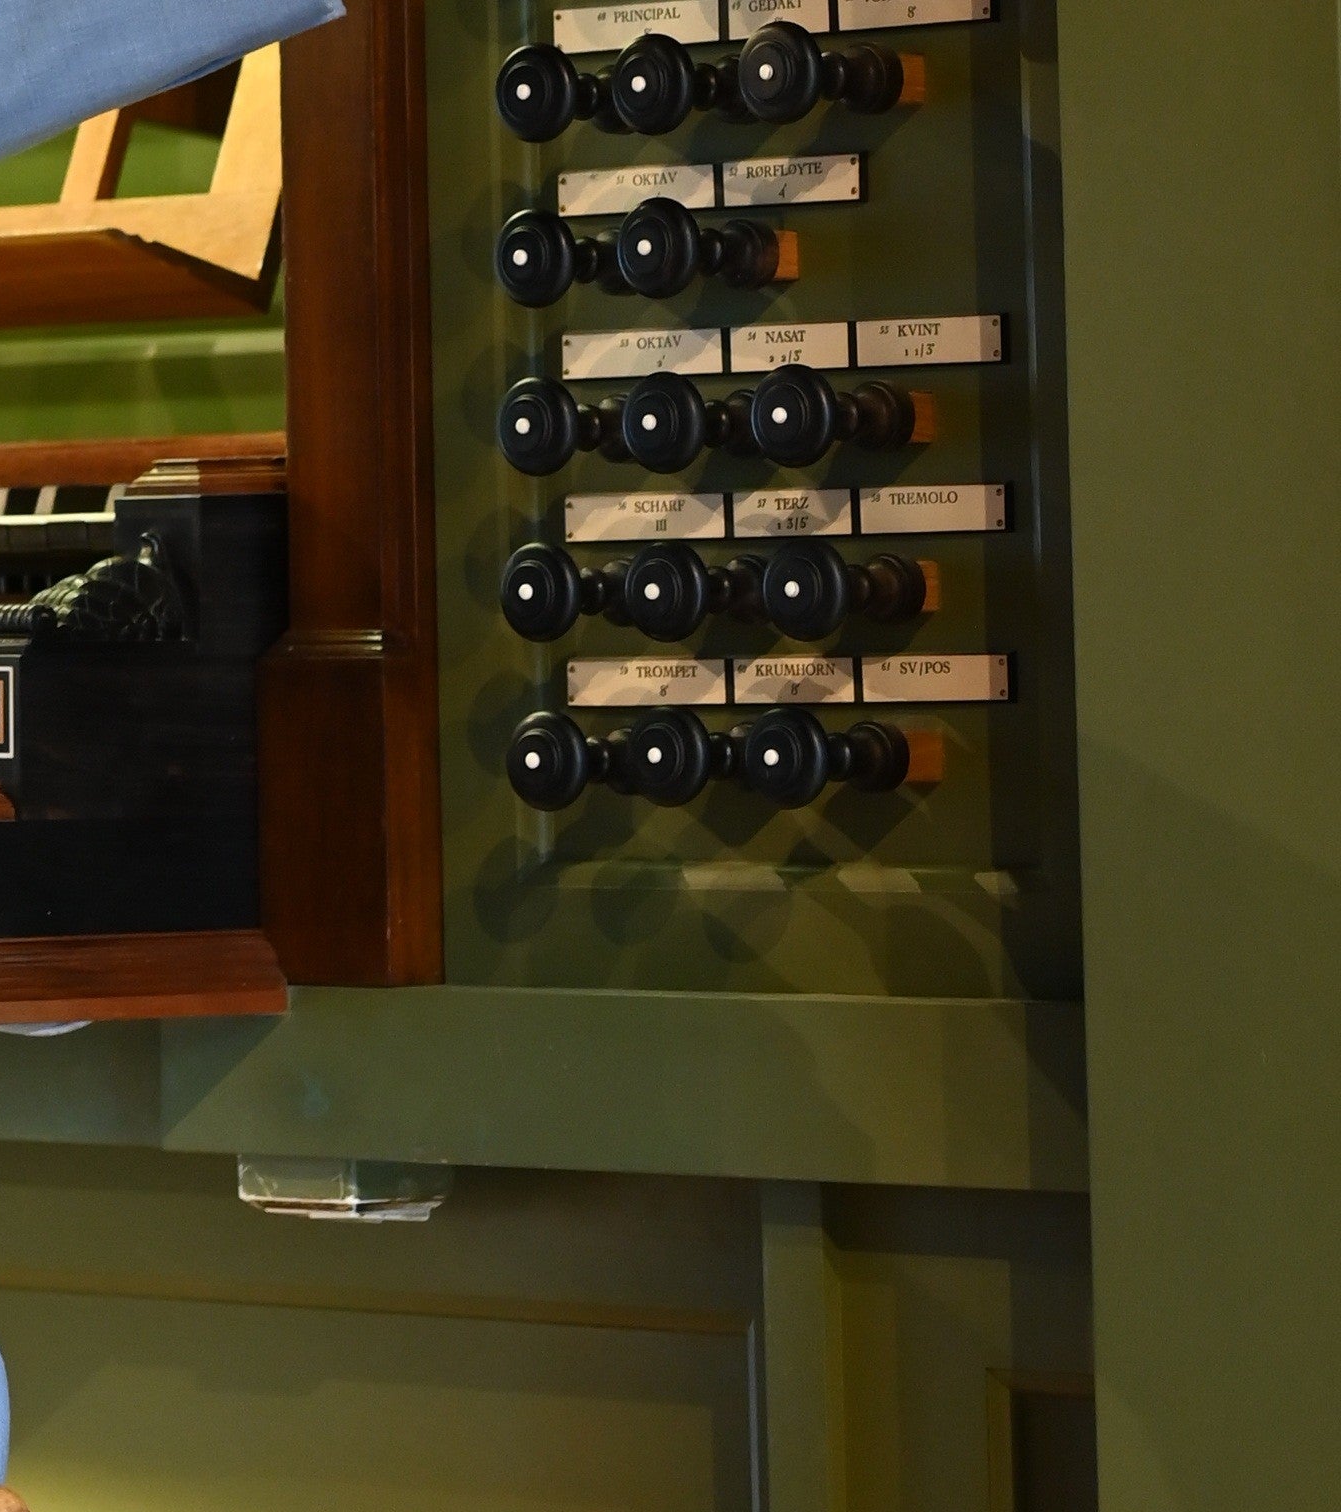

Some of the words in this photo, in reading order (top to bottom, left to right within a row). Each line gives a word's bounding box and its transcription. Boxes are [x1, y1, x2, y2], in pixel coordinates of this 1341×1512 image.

[614, 7, 681, 24] PRINCIPAL
[632, 171, 679, 187] OKTAV
[746, 162, 824, 180] RØRFLØYTE
[765, 329, 807, 344] NASAT
[897, 323, 941, 338] KVINT
[636, 334, 683, 350] OKTAV
[774, 496, 809, 511] TERZ
[888, 490, 959, 505] TREMOLO
[634, 499, 686, 513] SCHARF
[635, 664, 698, 680] TROMPET
[755, 662, 836, 678] KRUMHORN
[899, 660, 951, 676] SV/POS
